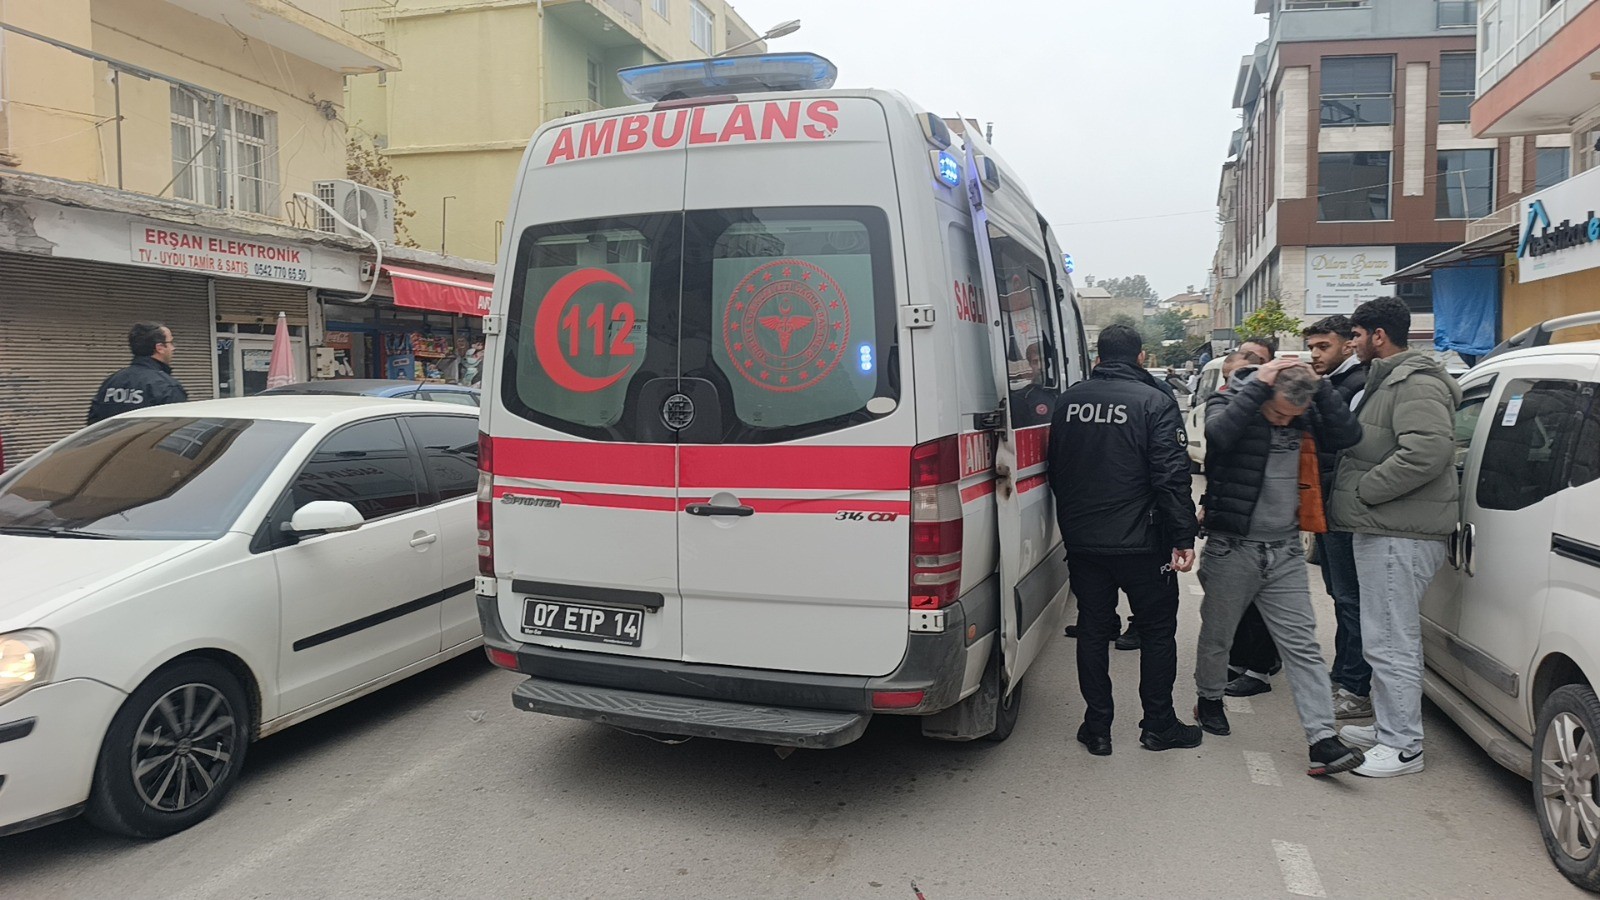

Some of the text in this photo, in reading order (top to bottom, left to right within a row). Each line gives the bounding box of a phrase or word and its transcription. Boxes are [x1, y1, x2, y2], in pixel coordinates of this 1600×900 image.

[545, 100, 839, 166] AMBULANS
[145, 228, 300, 263] ERŞAN ELEKTRONİK
[139, 249, 152, 262] TV
[159, 251, 185, 267] UYDU
[188, 254, 215, 270] TAMİR
[217, 259, 224, 270] &
[225, 260, 249, 277] SATIŞ
[254, 263, 272, 277] 0542
[273, 265, 287, 279] 770
[297, 268, 307, 281] 50
[954, 273, 988, 324] SAĞLI
[563, 301, 636, 357] 112
[965, 432, 993, 474] AMB
[835, 511, 899, 522] 316 CDI
[534, 603, 637, 638] 07 ETP 14
